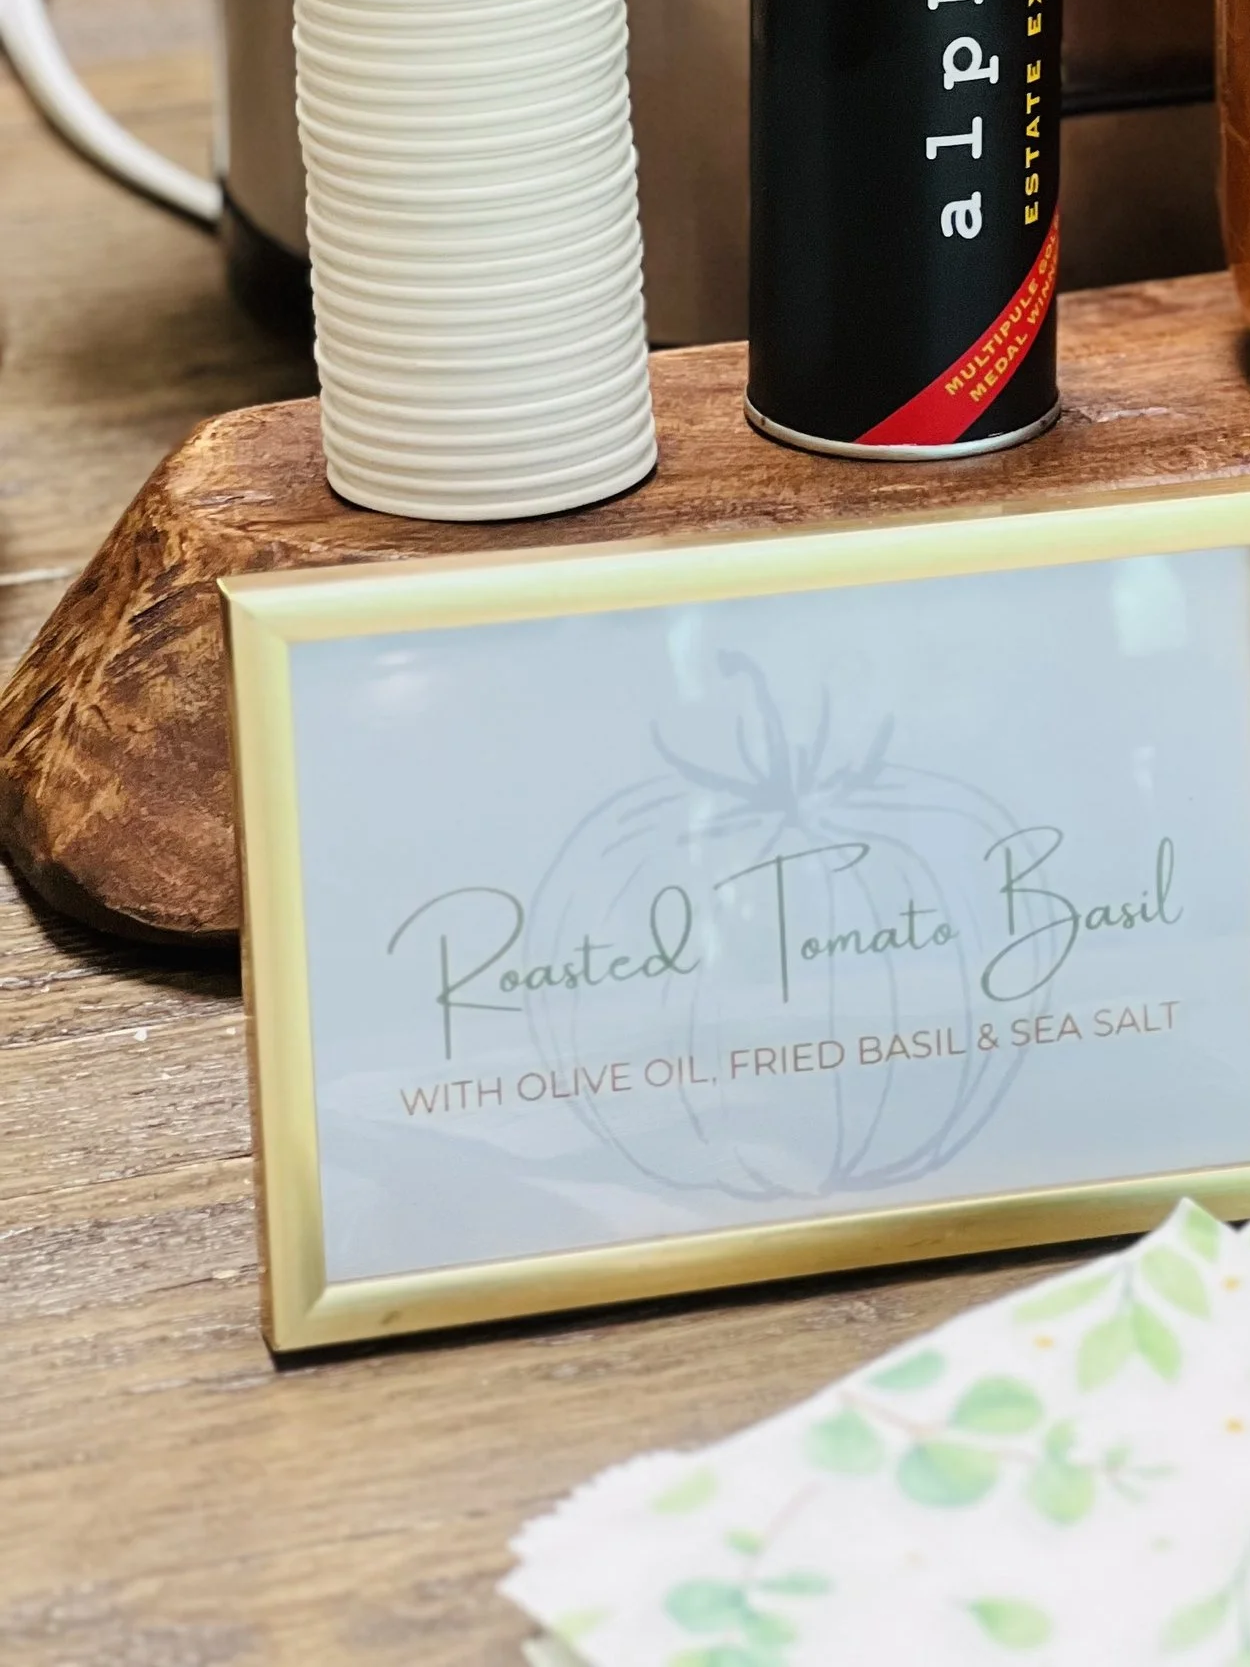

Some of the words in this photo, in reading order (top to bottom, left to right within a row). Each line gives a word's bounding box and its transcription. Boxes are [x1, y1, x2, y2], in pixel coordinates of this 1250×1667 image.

[1023, 62, 1042, 227] ESTATE
[944, 277, 1039, 396] MULTIPULE
[968, 332, 1029, 403] MEDAL
[387, 885, 701, 1061] Roasted
[713, 842, 960, 1004] Tomato
[980, 825, 1185, 1002] Basil
[400, 1077, 502, 1117] WITH
[517, 1062, 632, 1102] OLIVE
[644, 1054, 718, 1088] OIL,
[730, 1040, 845, 1080] FRIED
[859, 1027, 967, 1066] BASIL
[976, 1022, 1000, 1051] &
[1010, 1012, 1083, 1047] SEA
[1093, 1000, 1181, 1038] SALT
